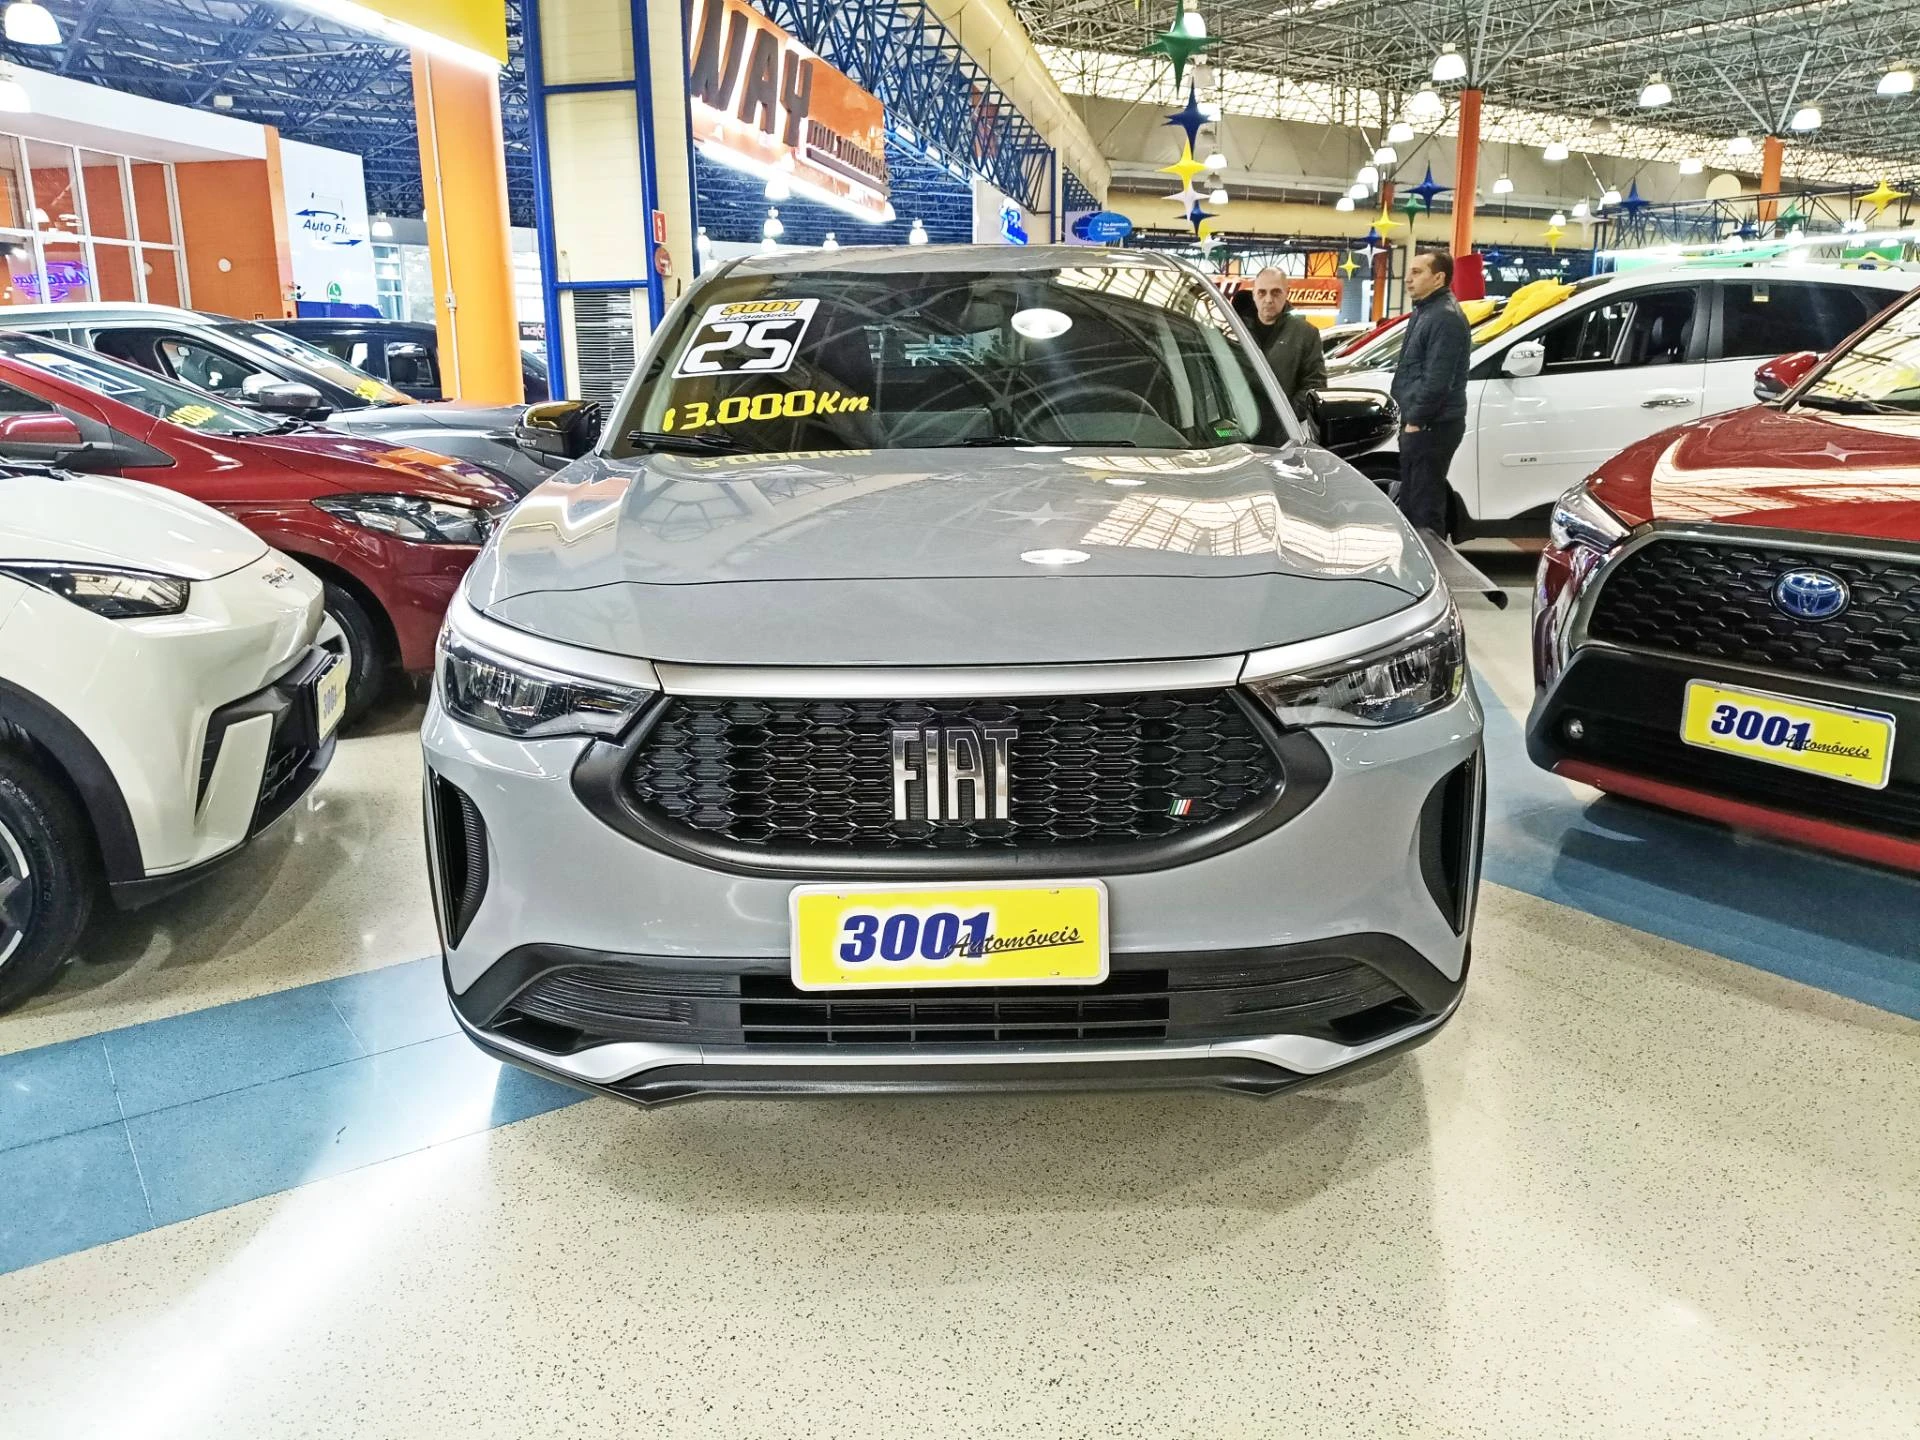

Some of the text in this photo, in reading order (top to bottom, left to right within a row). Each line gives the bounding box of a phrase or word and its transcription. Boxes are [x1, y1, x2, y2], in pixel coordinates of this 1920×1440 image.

[303, 219, 332, 233] Auto
[720, 301, 803, 315] 3001
[682, 320, 797, 373] 25
[1711, 704, 1872, 759] 3001 Automóveis
[892, 729, 1019, 820] FIAT
[839, 911, 1083, 963] 3001 Automóveis
